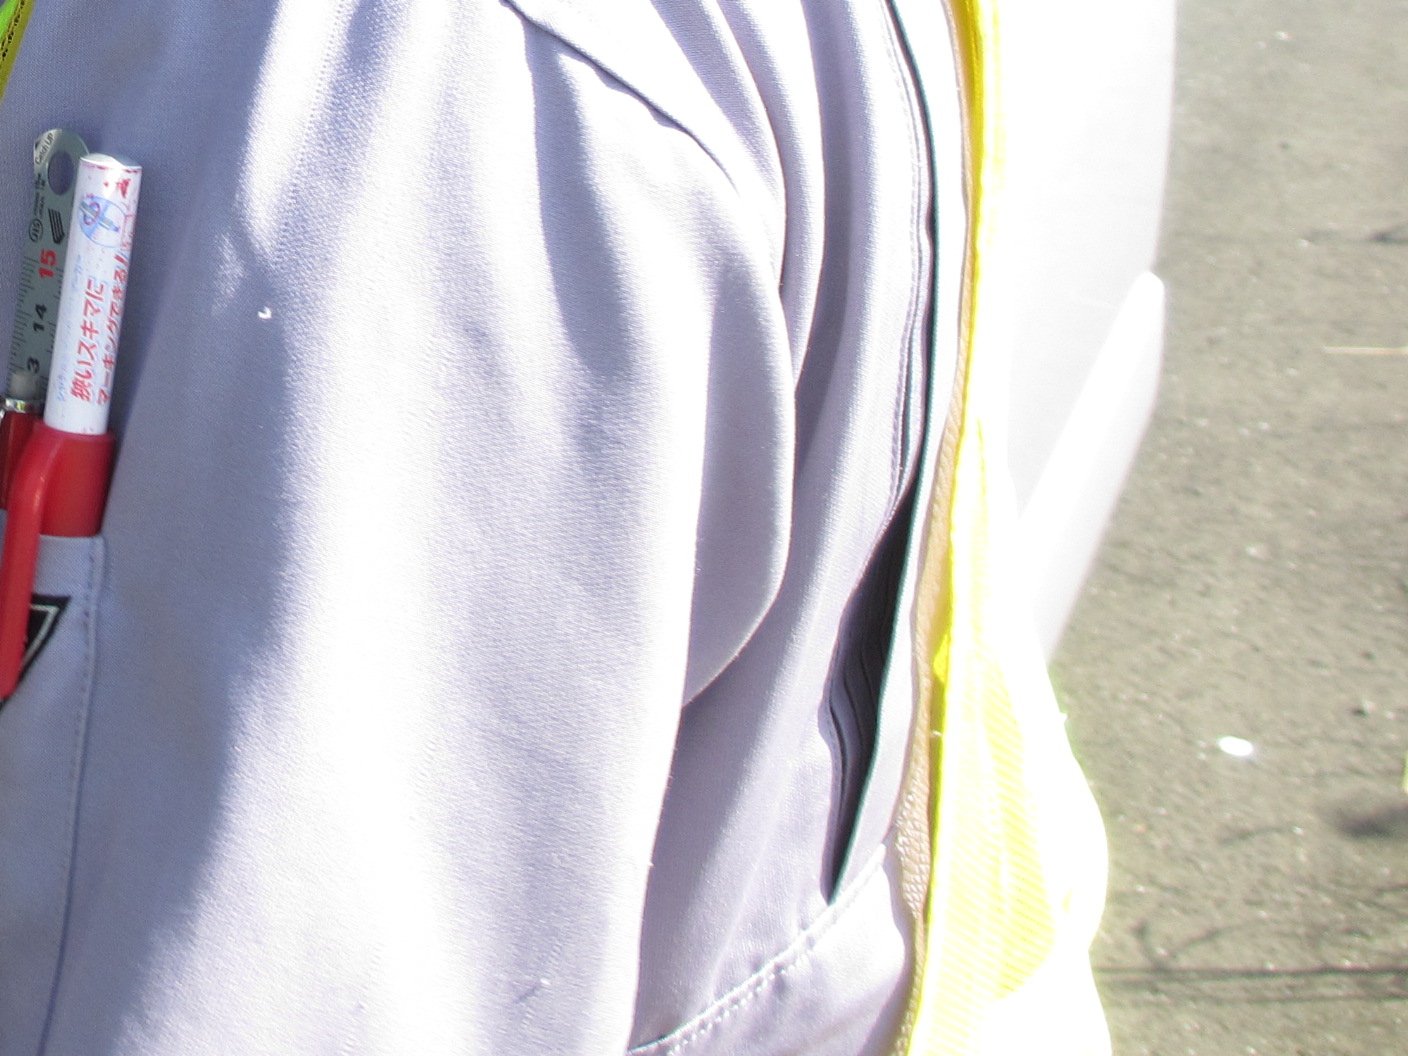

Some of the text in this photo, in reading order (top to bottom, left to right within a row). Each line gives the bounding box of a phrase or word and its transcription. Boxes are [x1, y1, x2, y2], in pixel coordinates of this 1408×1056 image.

[38, 248, 57, 278] 15
[33, 304, 47, 333] 14
[69, 278, 106, 402] 狭いスキマに
